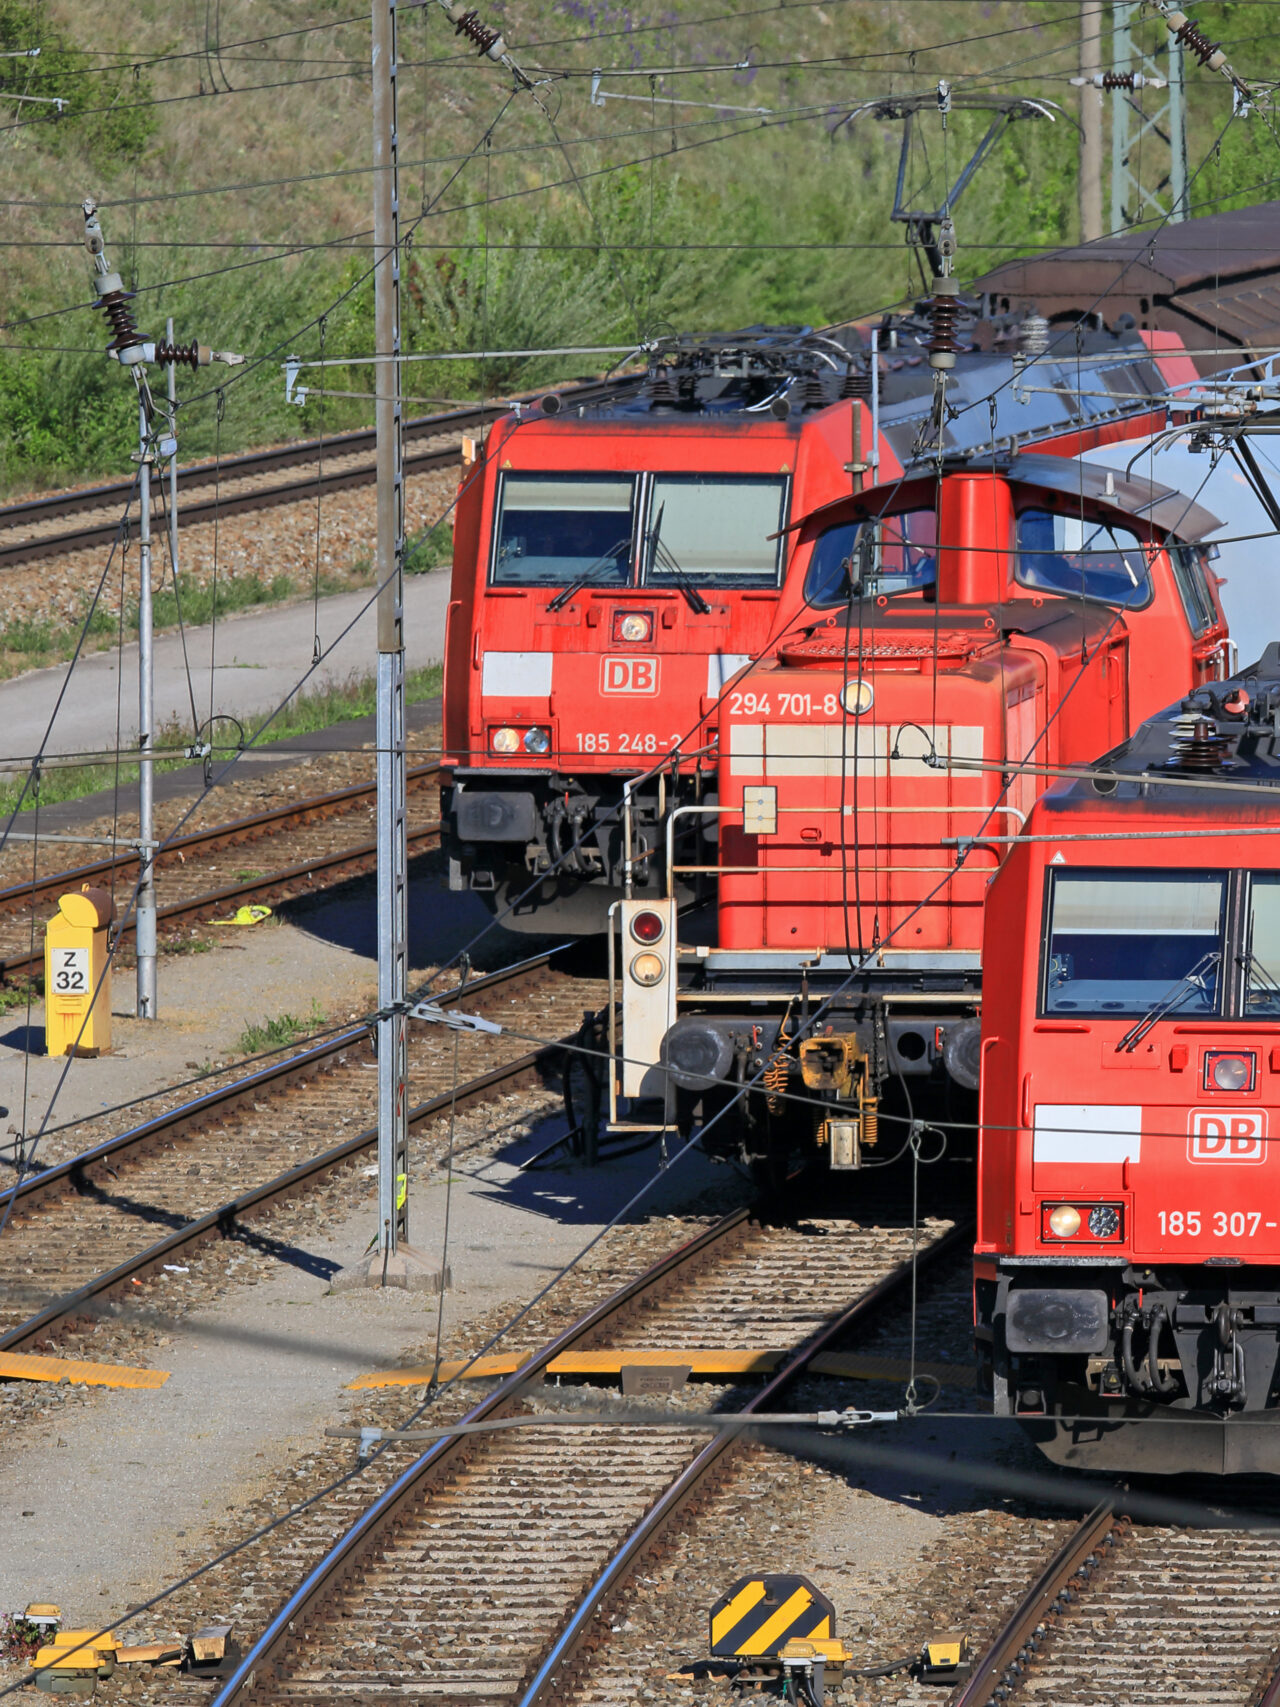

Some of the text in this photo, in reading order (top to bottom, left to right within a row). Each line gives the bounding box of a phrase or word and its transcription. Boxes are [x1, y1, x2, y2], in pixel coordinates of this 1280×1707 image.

[607, 660, 653, 690] DB
[729, 691, 838, 717] 294 701-8
[575, 732, 683, 754] 185 248-2
[64, 952, 76, 967] Z
[56, 971, 84, 990] 32
[1198, 1117, 1257, 1154] DB
[1157, 1210, 1202, 1237] 185
